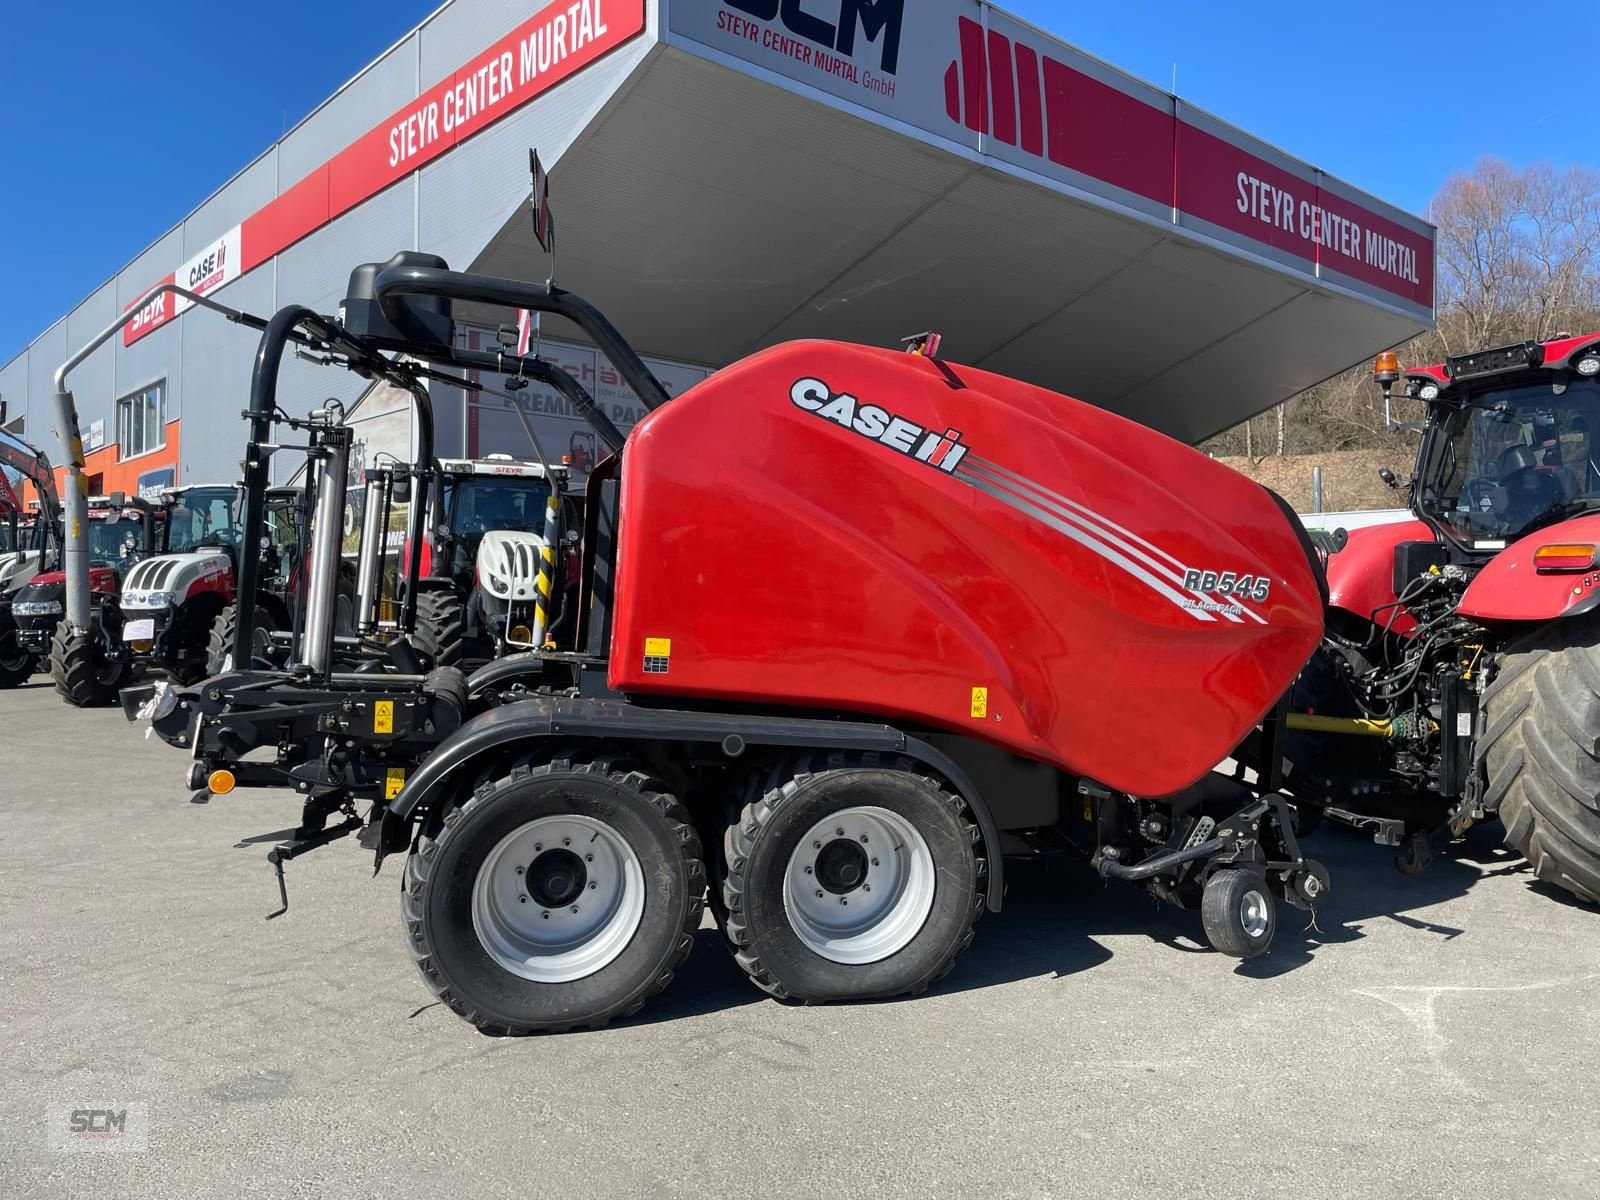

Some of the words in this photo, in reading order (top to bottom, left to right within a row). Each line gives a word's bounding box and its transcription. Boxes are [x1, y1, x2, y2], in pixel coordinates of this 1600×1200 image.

[389, 102, 438, 168] STEYR
[443, 51, 513, 133] CENTER
[519, 0, 607, 86] MURTAL
[717, 10, 759, 44] STEYR
[763, 29, 811, 65] CENTER
[814, 50, 859, 84] MURTAL
[863, 70, 896, 98] GmbH
[1237, 172, 1294, 233] STEYR
[1300, 201, 1361, 260] CENTER
[1366, 229, 1419, 284] MURTAL
[190, 252, 215, 287] CASE
[790, 377, 923, 454] CASE
[1182, 600, 1217, 610] SILAGE
[1219, 604, 1244, 615] PACK
[1183, 568, 1270, 602] RB545
